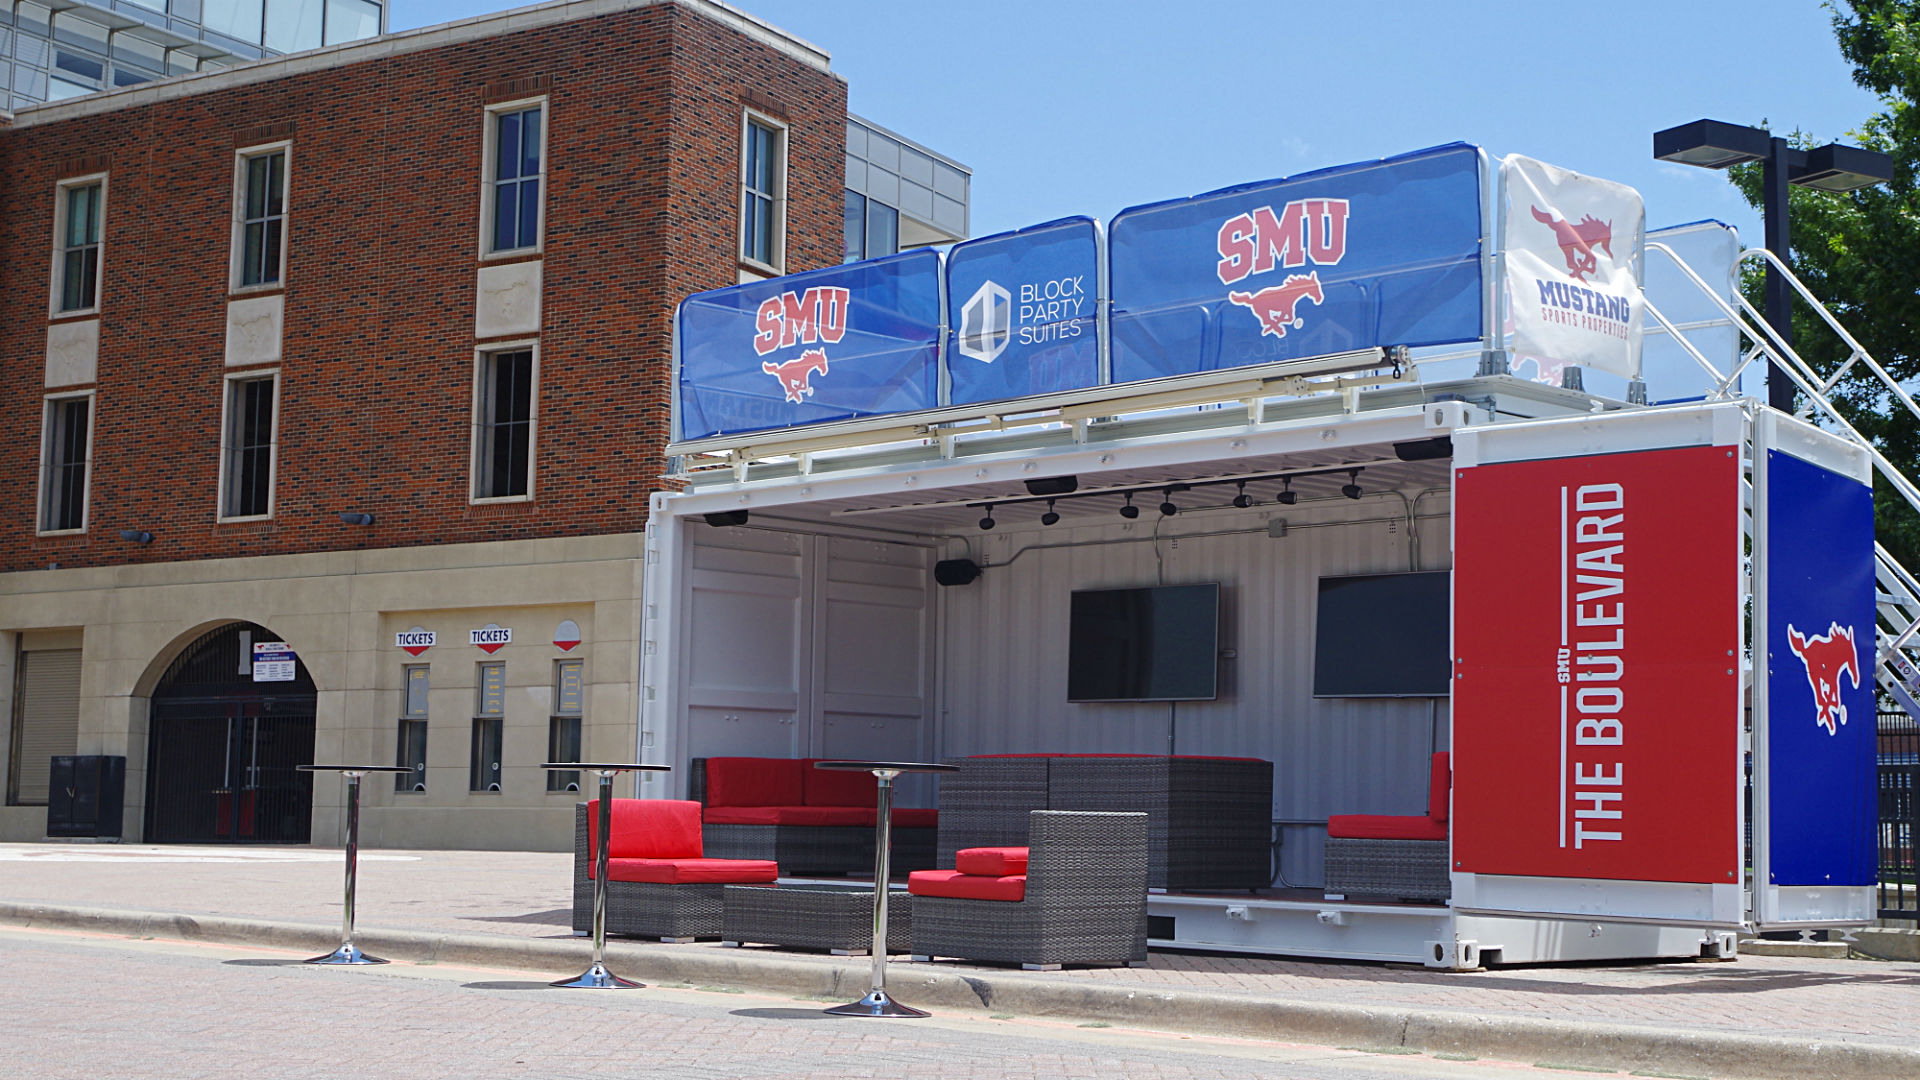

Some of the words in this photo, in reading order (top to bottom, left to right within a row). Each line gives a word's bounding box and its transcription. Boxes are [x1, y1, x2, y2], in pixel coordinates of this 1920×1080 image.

[1217, 197, 1350, 286] SMU
[1020, 275, 1084, 303] BLOCK
[1536, 278, 1630, 324] MUSTANG
[753, 286, 850, 356] SMU
[1019, 296, 1084, 324] PARTY
[1541, 307, 1578, 328] SPORTS
[1581, 315, 1629, 340] PROPERTIES
[1019, 318, 1082, 345] SUITES
[1575, 482, 1624, 746] BOULEVARD
[397, 632, 434, 645] TICKETS
[472, 629, 509, 643] TICKETS
[1557, 646, 1571, 684] SMU
[1574, 761, 1623, 850] THE
